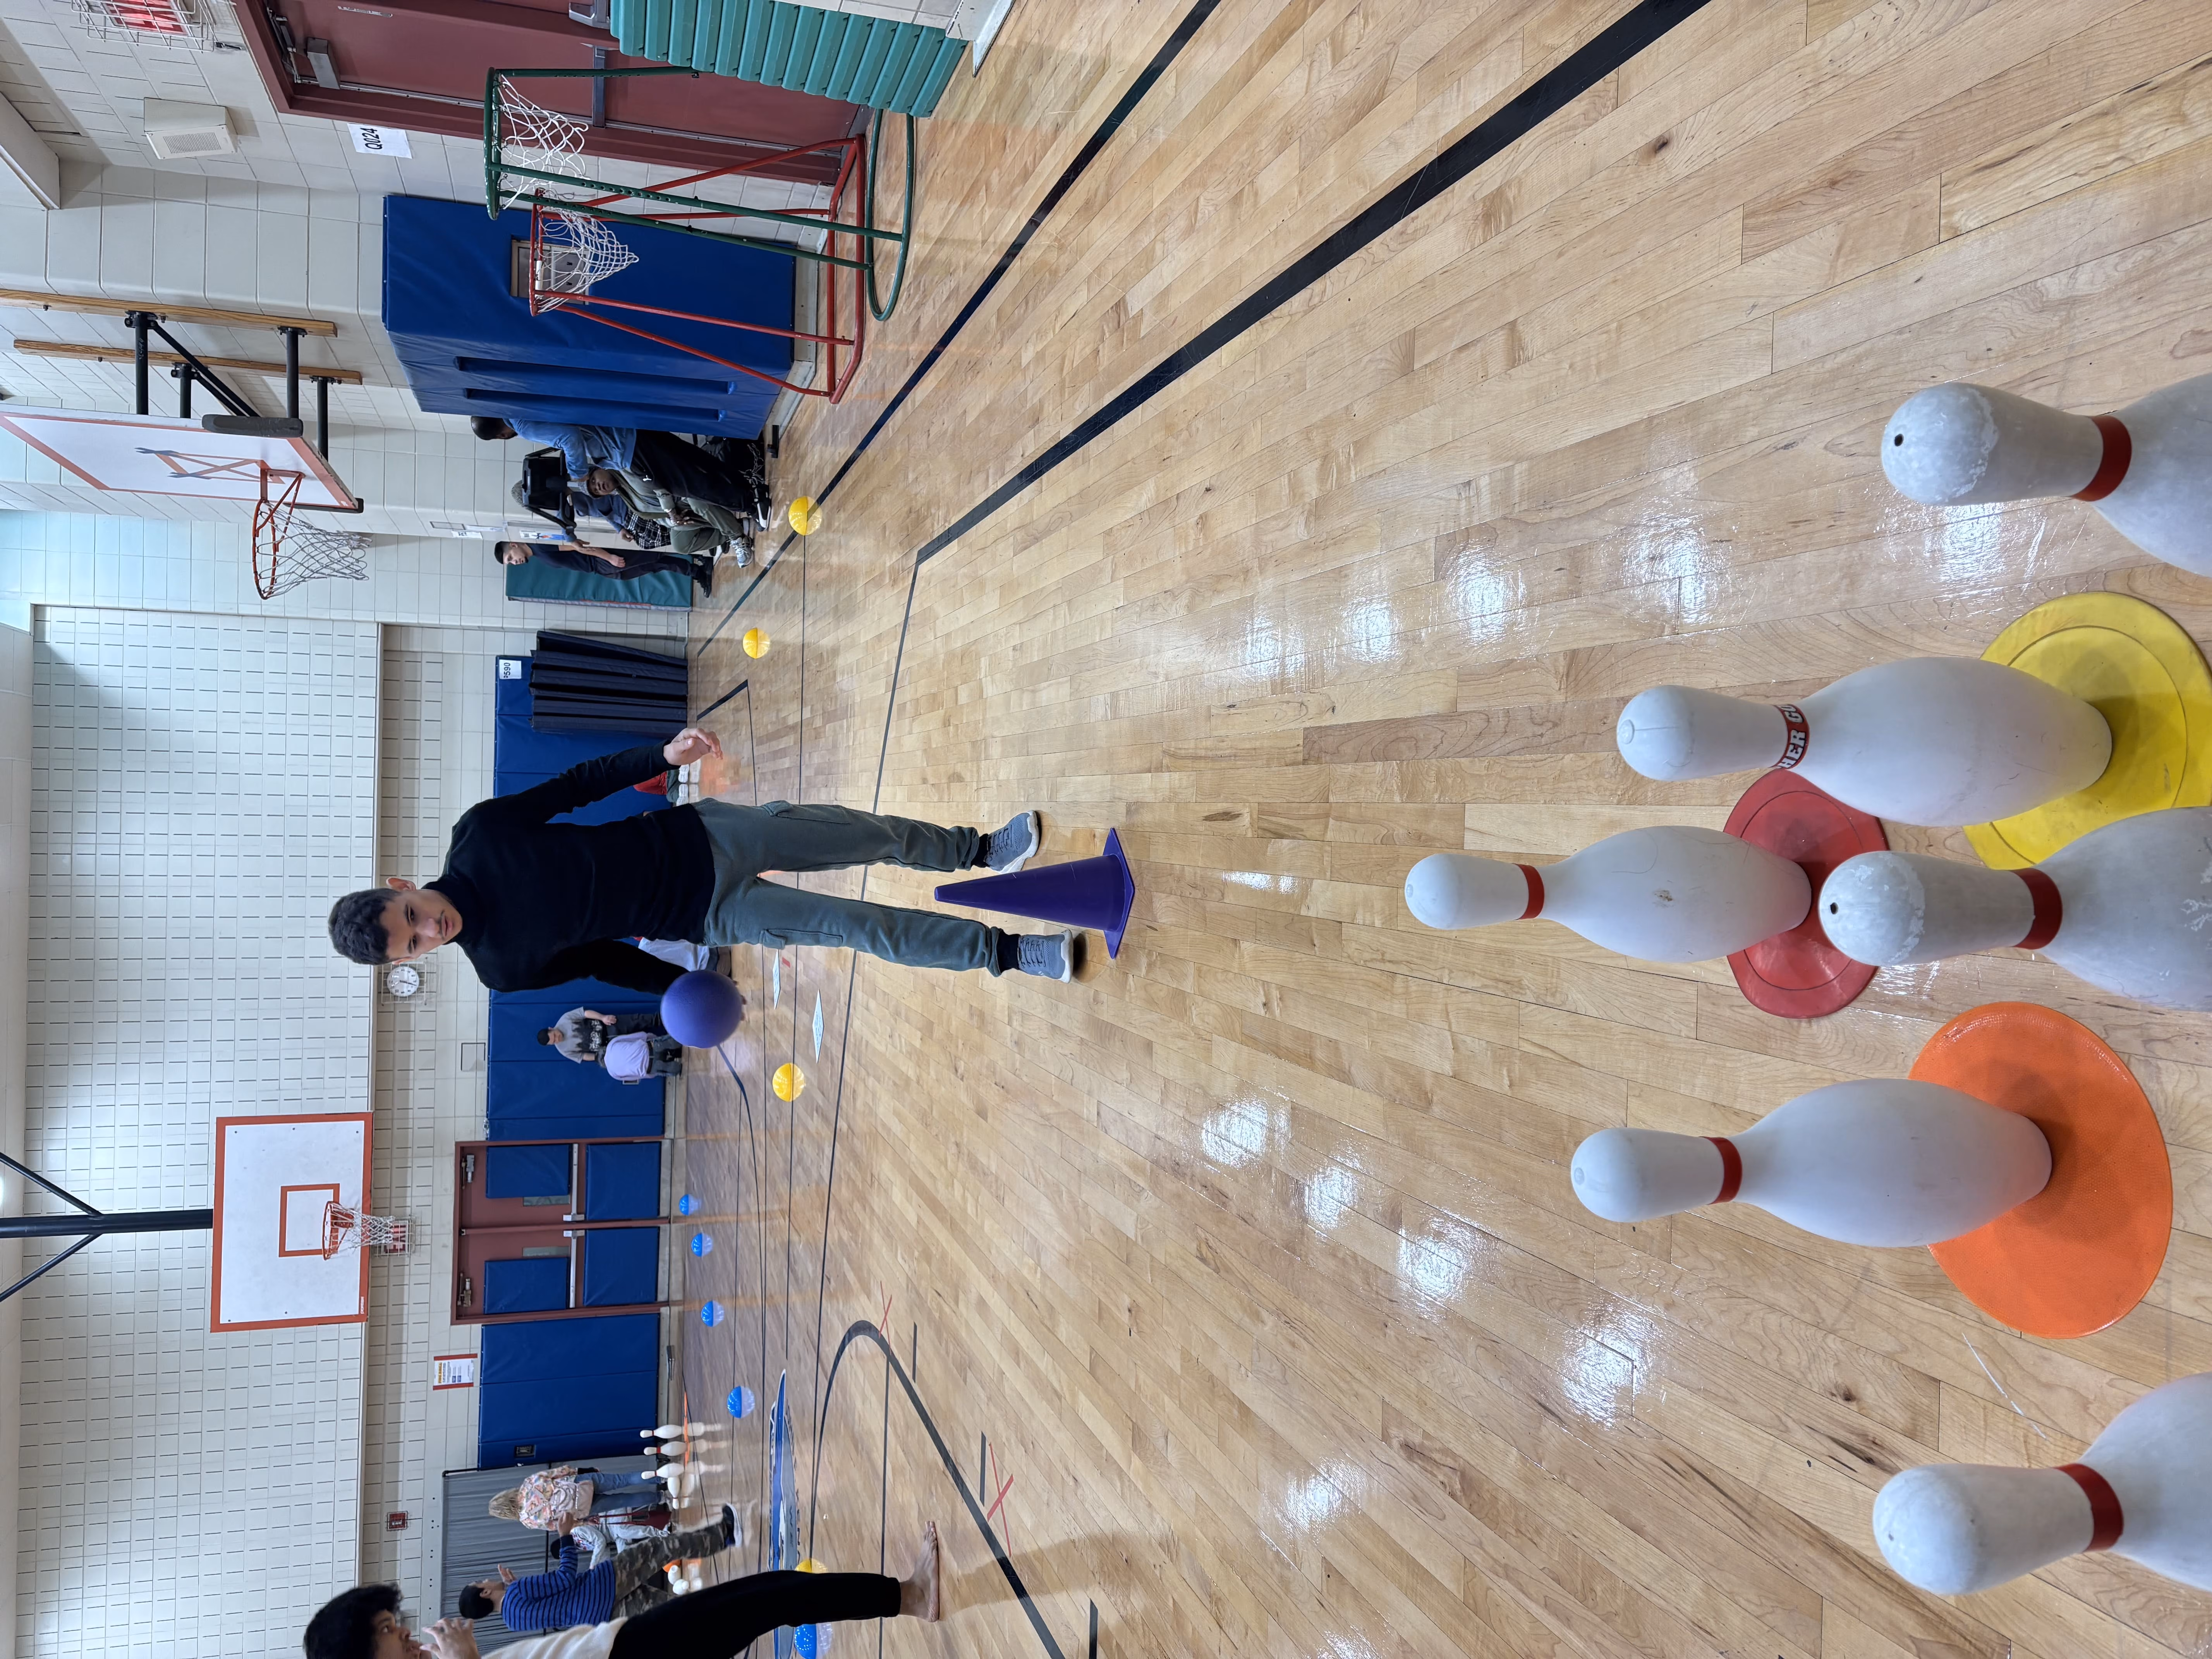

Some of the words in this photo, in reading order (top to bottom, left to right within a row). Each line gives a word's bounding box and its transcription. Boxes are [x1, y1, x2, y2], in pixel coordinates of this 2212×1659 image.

[105, 0, 183, 32] EXI
[360, 127, 383, 150] Q024
[1773, 730, 1806, 768] HER
